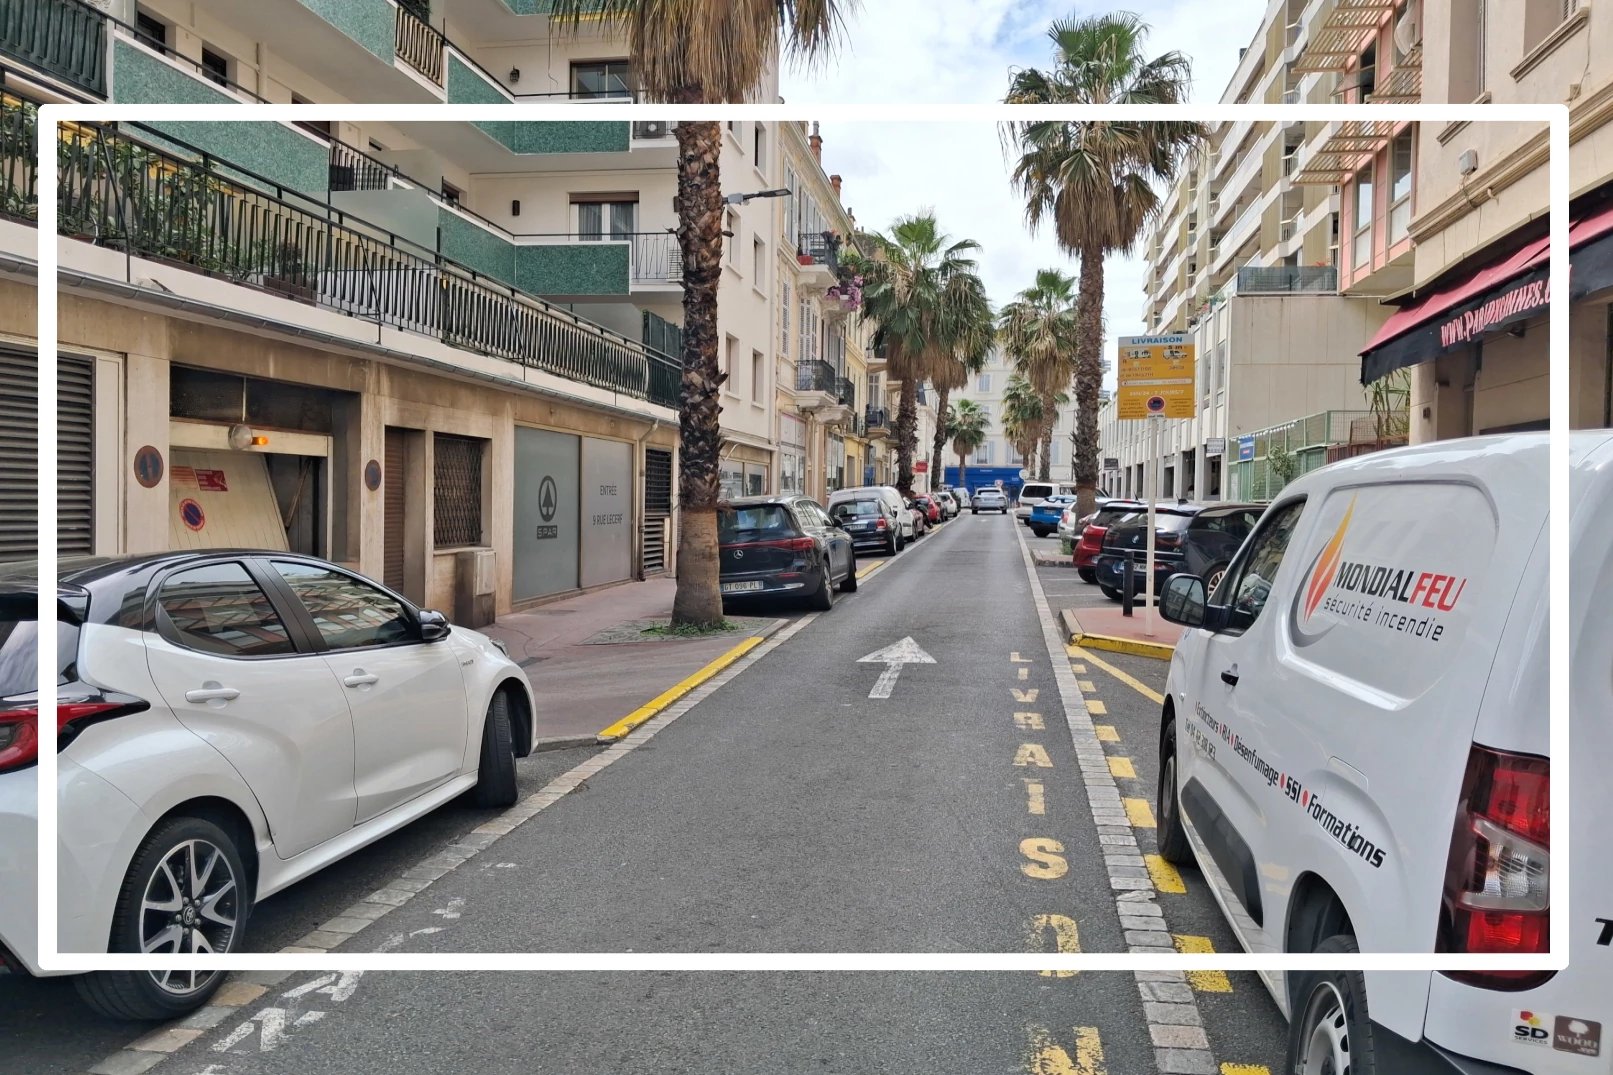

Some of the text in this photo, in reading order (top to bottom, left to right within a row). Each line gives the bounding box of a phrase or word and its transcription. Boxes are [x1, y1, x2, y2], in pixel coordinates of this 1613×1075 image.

[1131, 336, 1183, 345] LIVRAISON
[537, 526, 557, 538] SPAR
[1334, 561, 1467, 612] MONDIALFEU
[1324, 594, 1444, 642] sécurité incendie
[1234, 734, 1279, 787] Désenfumage
[1285, 776, 1302, 803] SSI
[1307, 794, 1386, 868] Formations
[1515, 1026, 1549, 1039] SD
[1514, 1035, 1548, 1045] SERVICES
